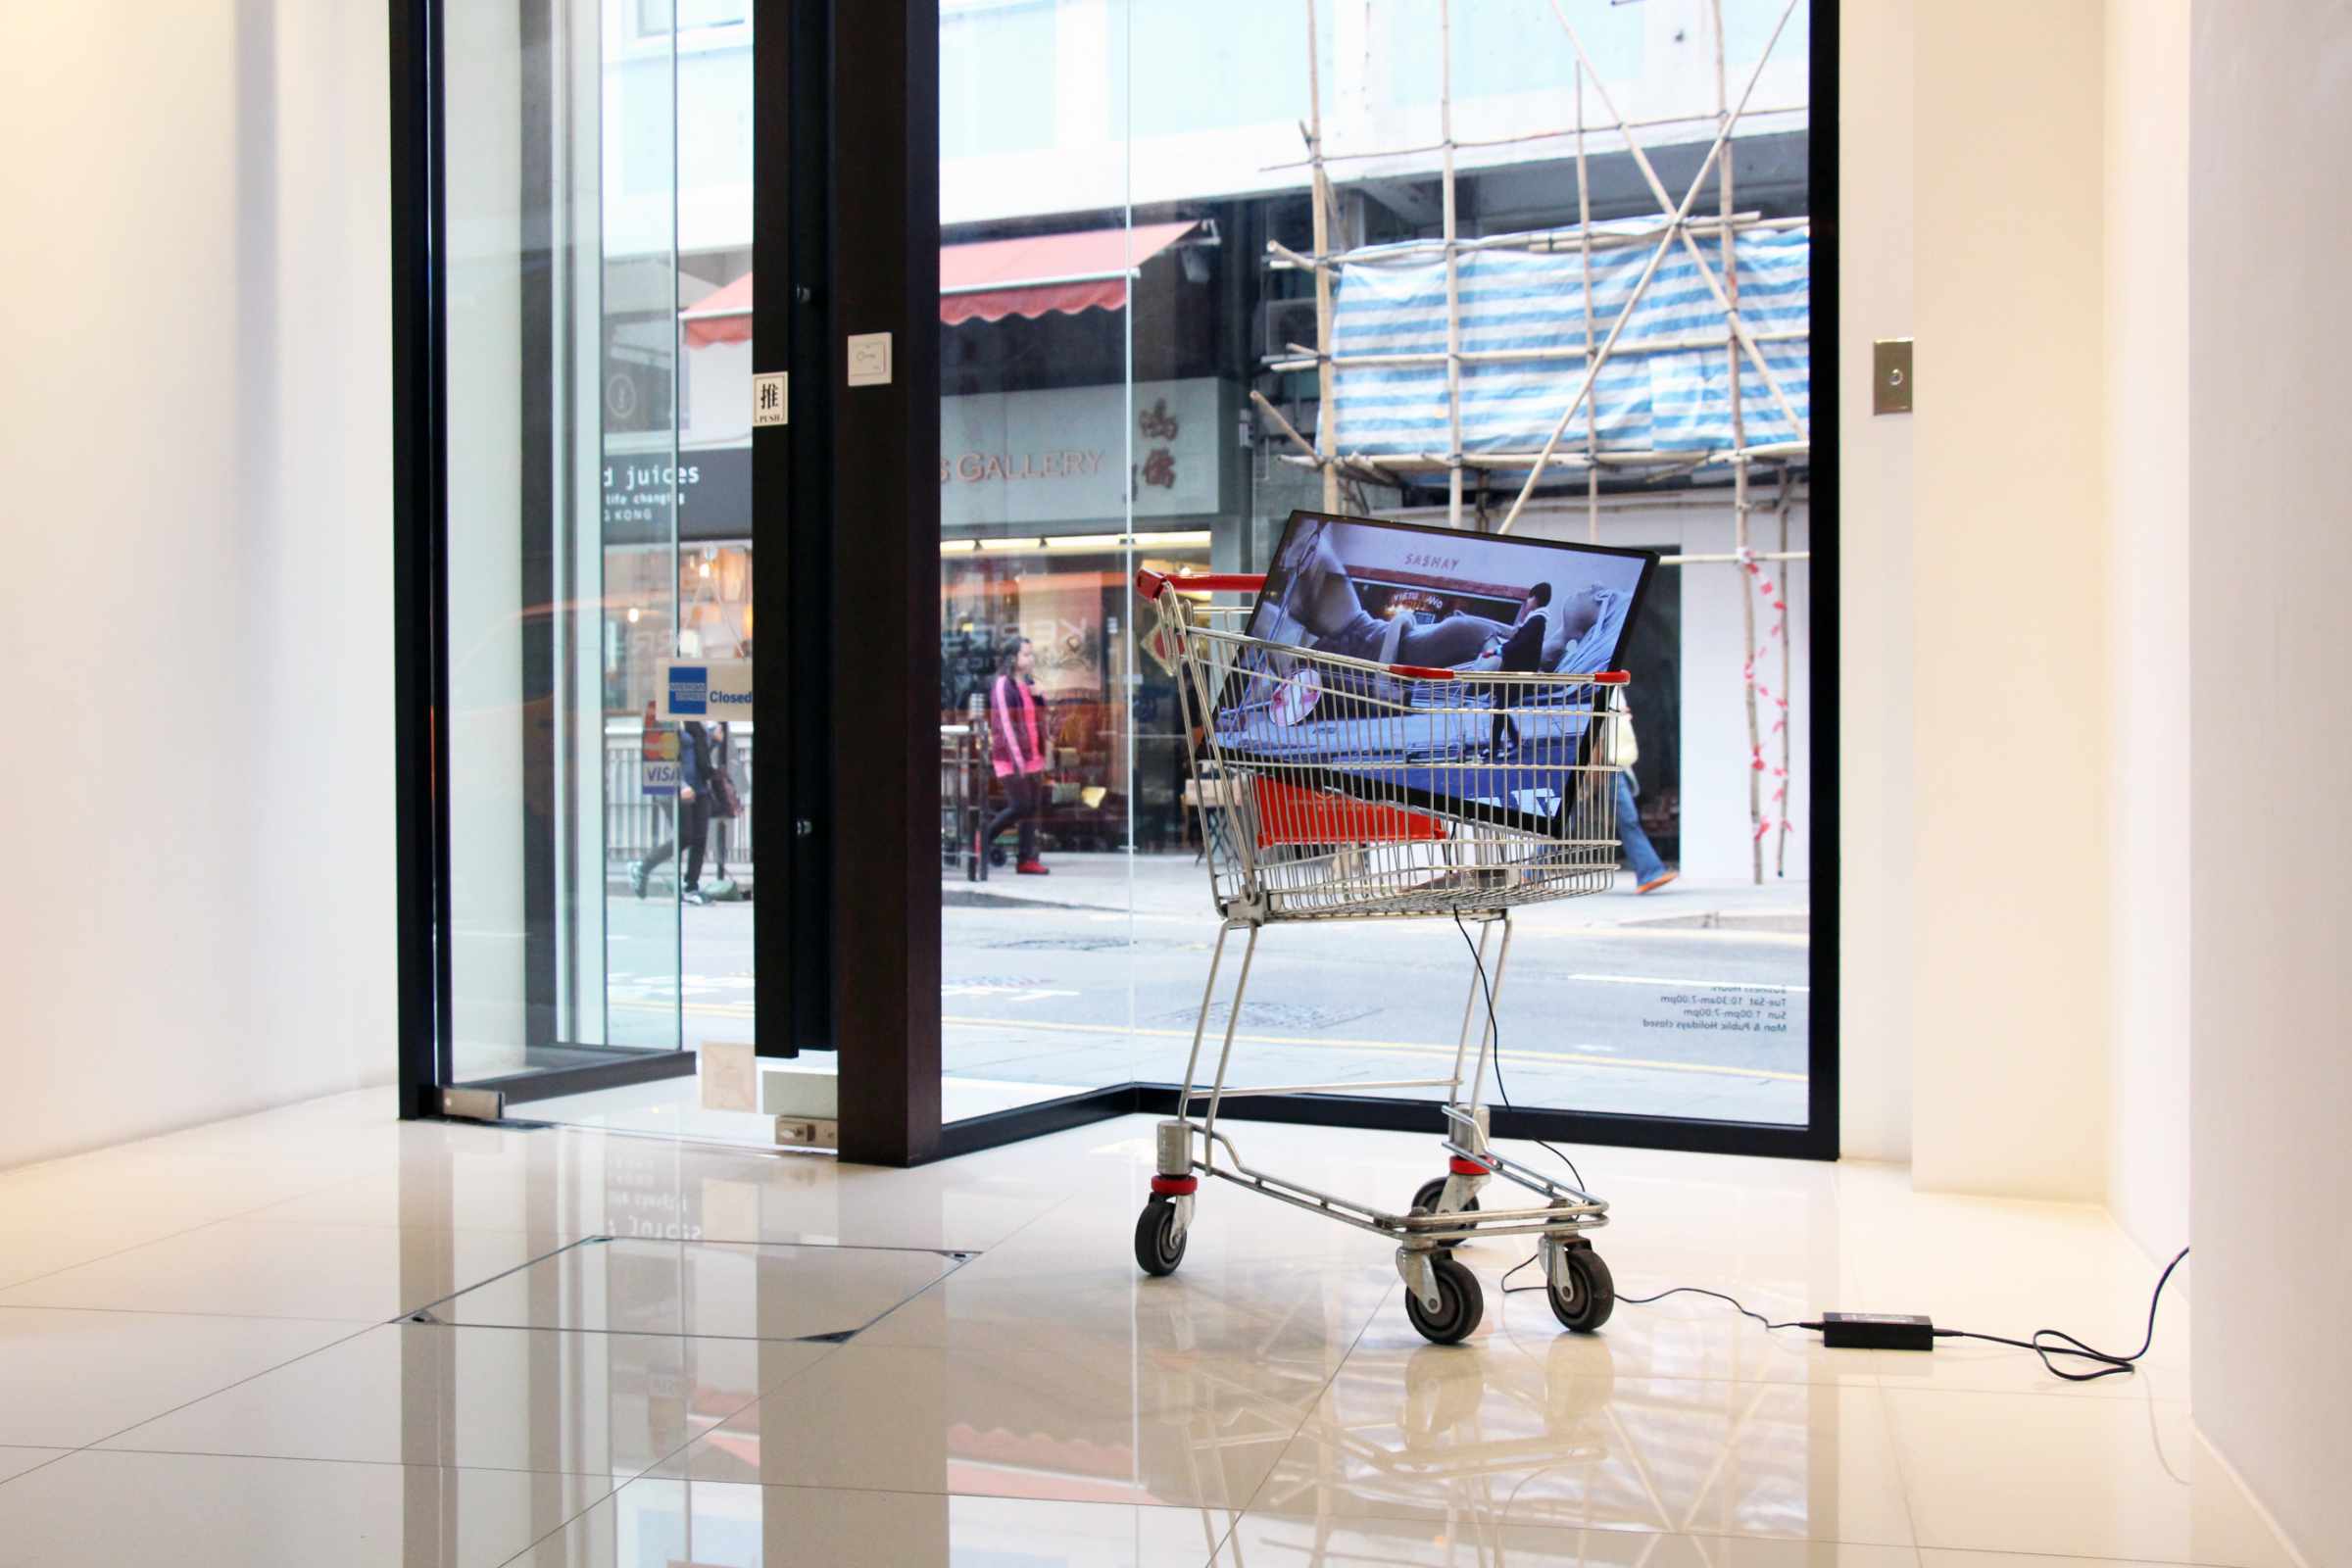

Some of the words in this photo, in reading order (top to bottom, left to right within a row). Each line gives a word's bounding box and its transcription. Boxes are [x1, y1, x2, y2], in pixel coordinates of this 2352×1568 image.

[760, 383, 779, 410] 推
[760, 414, 780, 423] PUSH
[956, 450, 1105, 483] GALLERY
[625, 464, 700, 491] juices
[632, 491, 685, 507] changig
[614, 509, 653, 521] KONG
[710, 690, 754, 704] Closed
